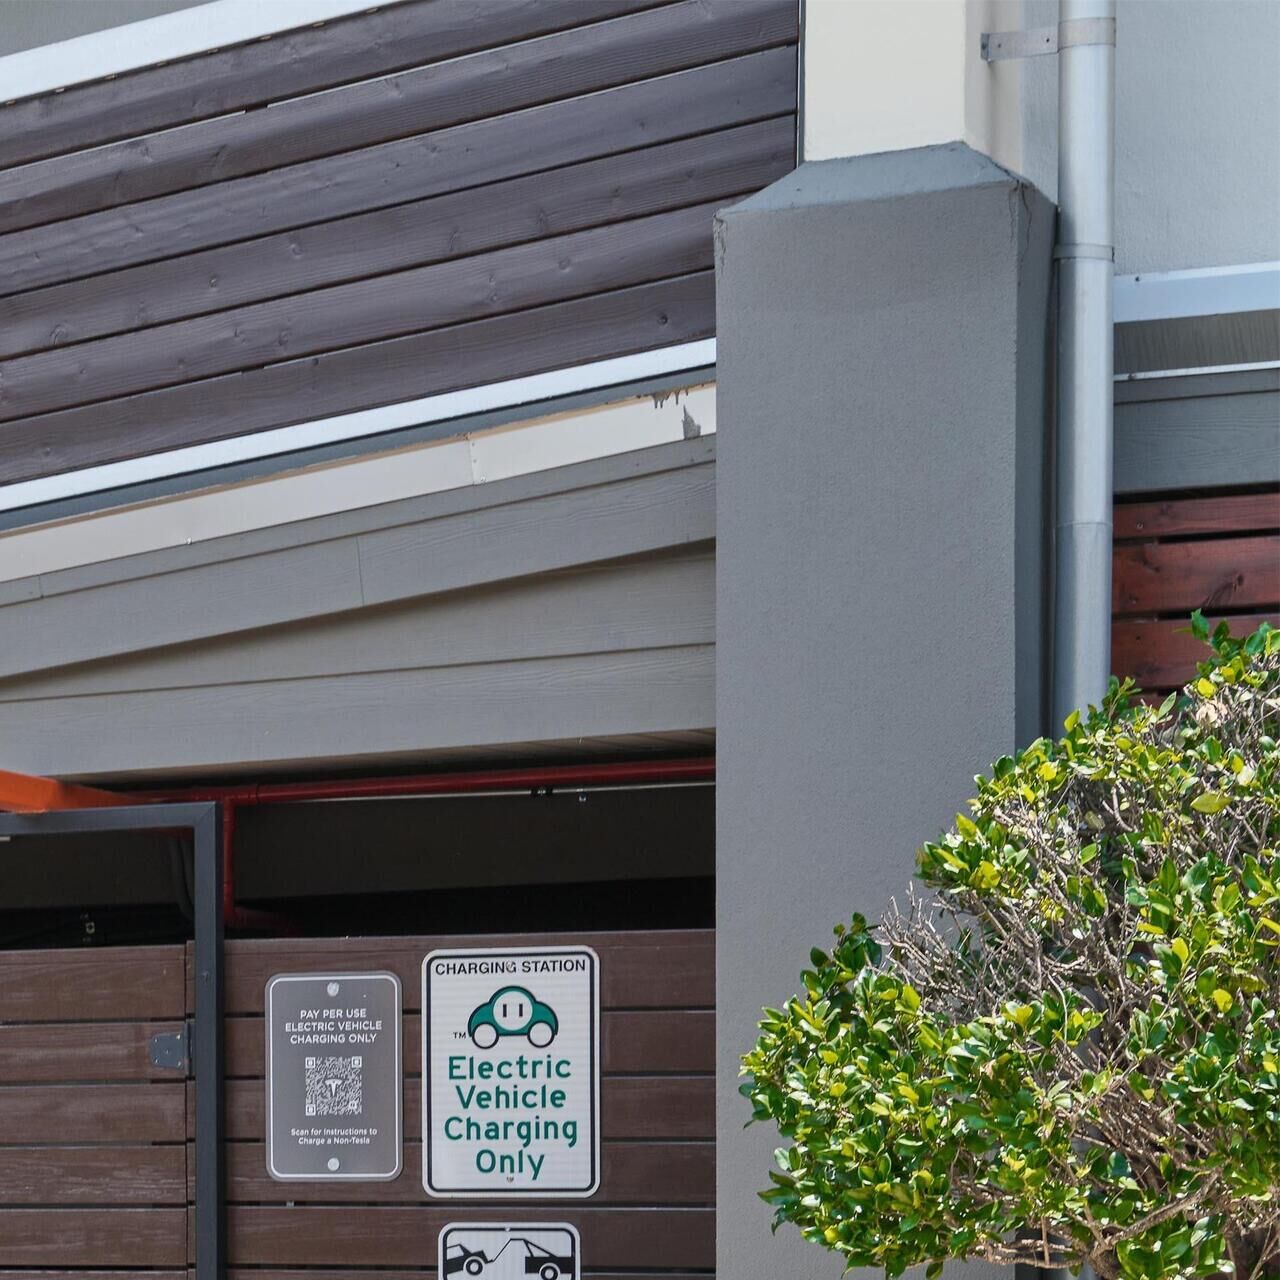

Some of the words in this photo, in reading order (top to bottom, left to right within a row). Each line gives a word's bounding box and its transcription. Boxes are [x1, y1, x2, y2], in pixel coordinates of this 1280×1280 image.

[435, 962, 516, 975] CHARGING
[521, 959, 586, 973] STATION
[300, 1009, 320, 1019] PAY
[323, 1009, 343, 1019] PER
[346, 1008, 367, 1018] USE
[285, 1022, 335, 1032] ELECTRIC
[338, 1020, 382, 1031] VEHICLE
[290, 1034, 346, 1045] CHARGING
[348, 1033, 377, 1043] ONLY
[448, 1055, 571, 1080] Electric
[456, 1084, 567, 1109] Vehicle
[291, 1128, 309, 1136] Scan
[311, 1128, 322, 1136] for
[369, 1127, 378, 1135] to
[444, 1116, 578, 1148] Charging
[298, 1137, 325, 1146] Charge
[333, 1137, 370, 1145] Non-Tesla
[476, 1149, 545, 1180] Only
